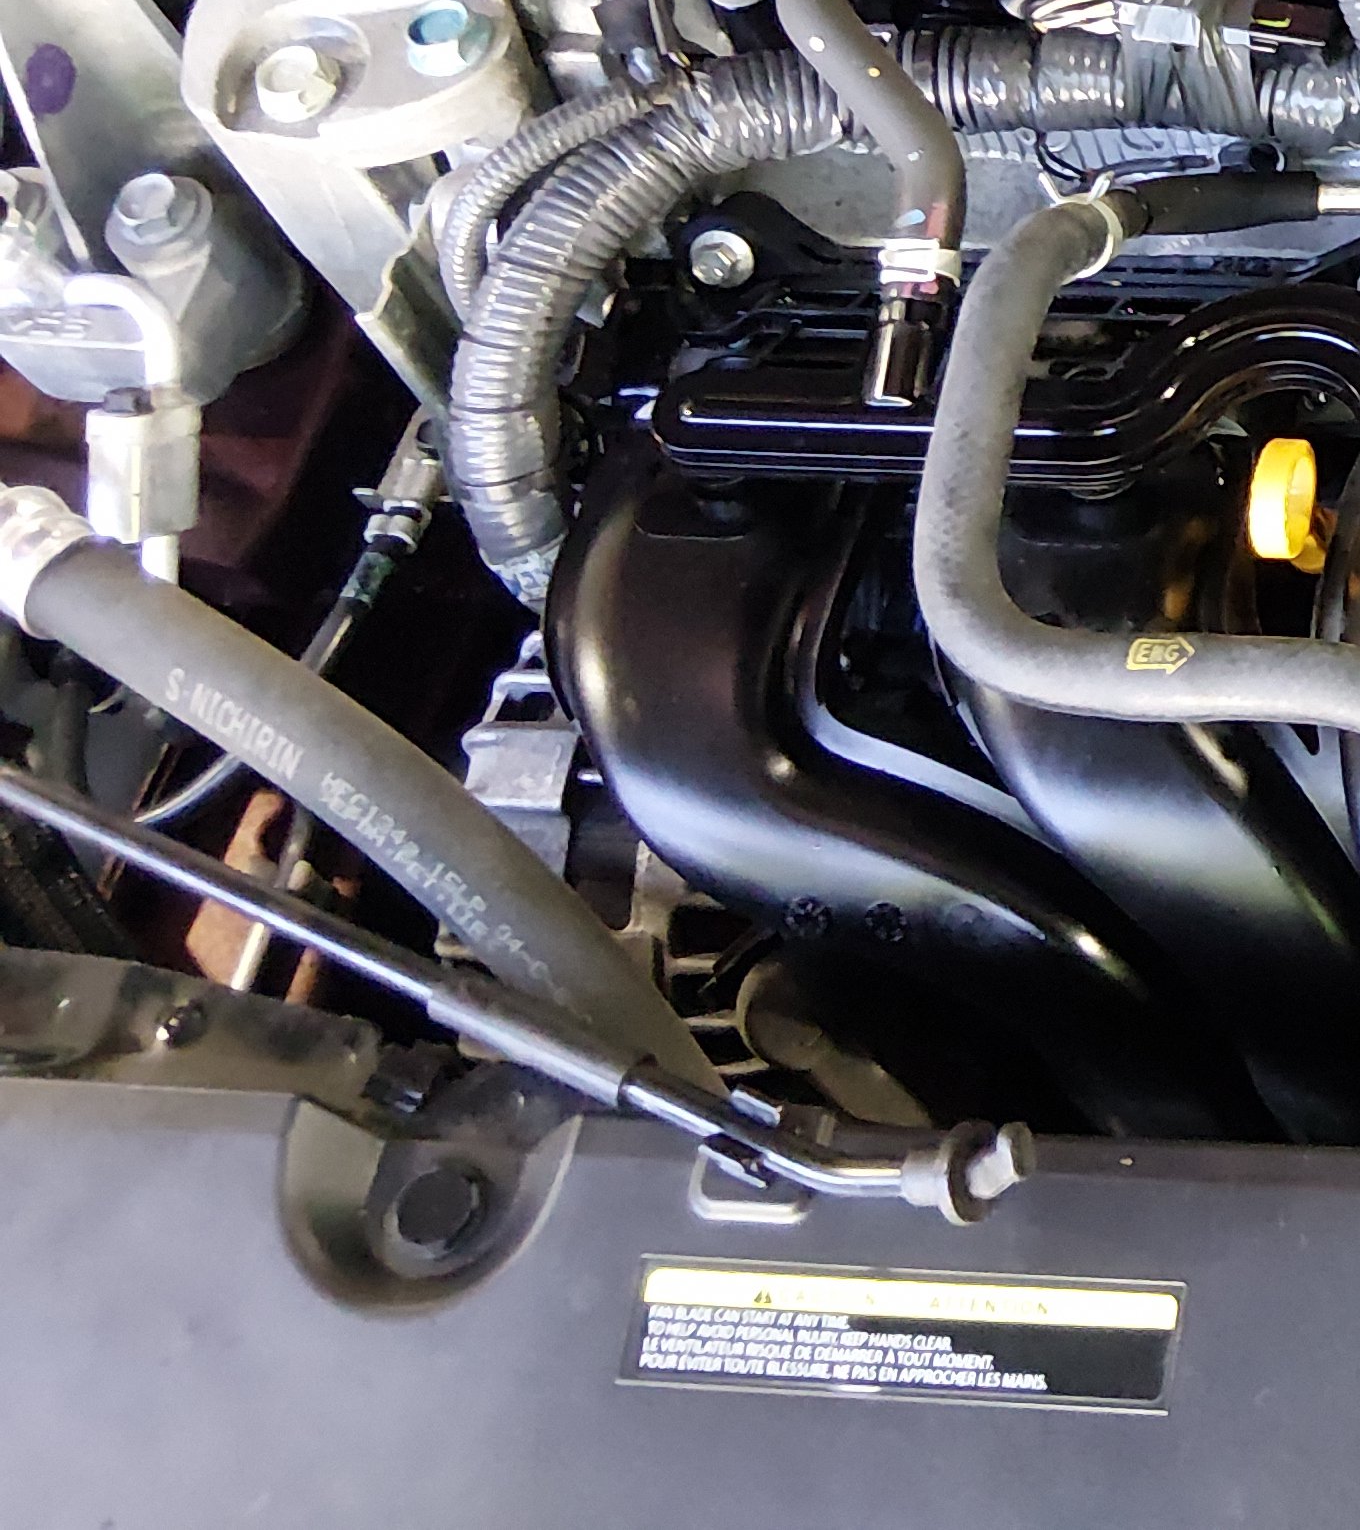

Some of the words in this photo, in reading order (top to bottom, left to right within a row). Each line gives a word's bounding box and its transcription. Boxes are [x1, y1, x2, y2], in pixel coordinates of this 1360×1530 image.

[164, 668, 302, 780] S-NICHIRIN
[675, 1306, 712, 1322] BLADE
[714, 1309, 740, 1323] CAN
[742, 1310, 776, 1325] START
[777, 1313, 793, 1326] AT
[793, 1313, 820, 1327] ANY
[648, 1320, 665, 1335] TO
[665, 1322, 697, 1336] HELP
[697, 1324, 735, 1339] AVOID
[735, 1326, 794, 1343] PERSONAL
[840, 1332, 868, 1346] KEEP
[868, 1333, 912, 1349] HANDS
[643, 1336, 660, 1352] LE
[660, 1339, 745, 1356] VENTILATEUR
[746, 1342, 792, 1359] RISQUE
[794, 1345, 812, 1360] DE
[897, 1350, 933, 1367] TOUT
[639, 1353, 678, 1369] POUR
[724, 1358, 765, 1374] TOUTE
[833, 1364, 851, 1379] NE
[851, 1366, 877, 1381] PAS
[878, 1367, 897, 1382] EN
[899, 1368, 976, 1387] APPROCHER
[978, 1372, 1001, 1388] LES
